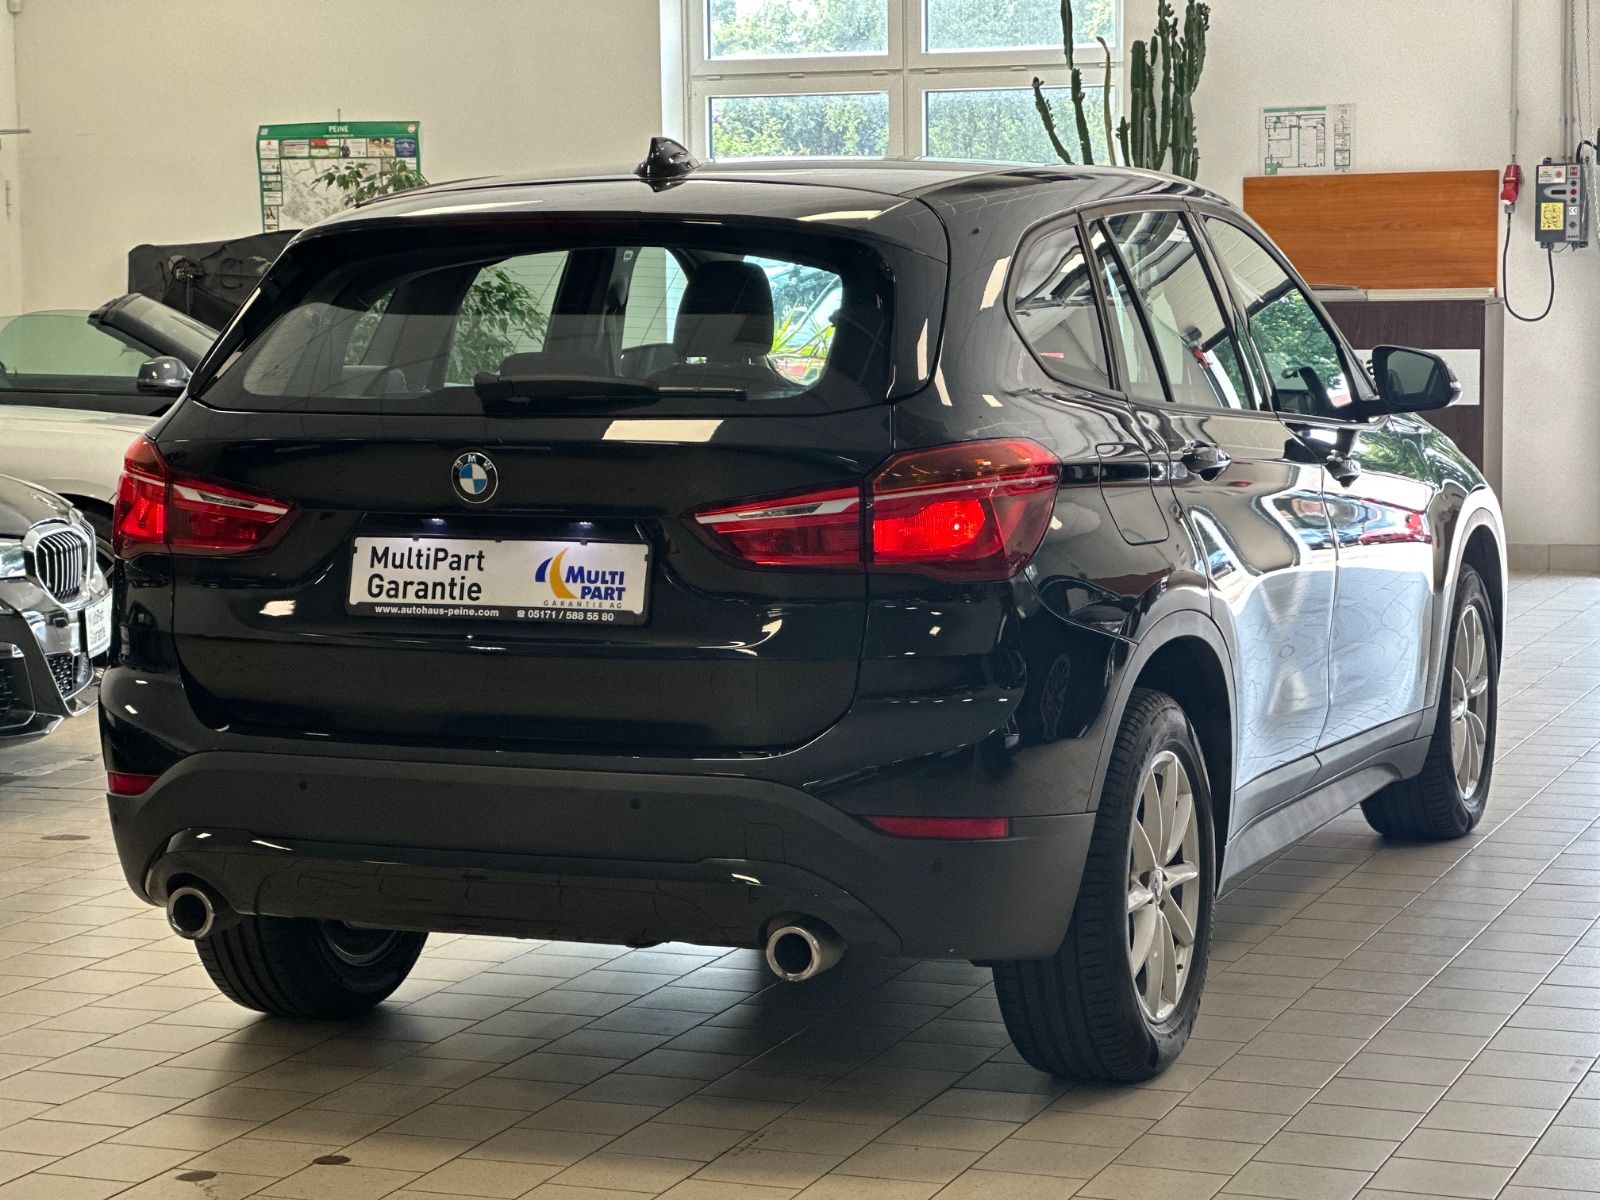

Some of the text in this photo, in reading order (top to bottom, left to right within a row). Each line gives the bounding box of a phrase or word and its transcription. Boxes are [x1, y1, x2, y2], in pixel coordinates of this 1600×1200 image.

[454, 454, 493, 471] BMW
[369, 545, 485, 572] MultiPart
[367, 573, 482, 601] Garantie
[580, 585, 626, 601] PART
[374, 605, 500, 617] www.autohaus-peine.com
[543, 599, 602, 608] GARANTIE
[527, 609, 556, 619] 05171
[566, 611, 584, 620] 588
[586, 612, 600, 620] 55
[601, 612, 615, 621] 80
